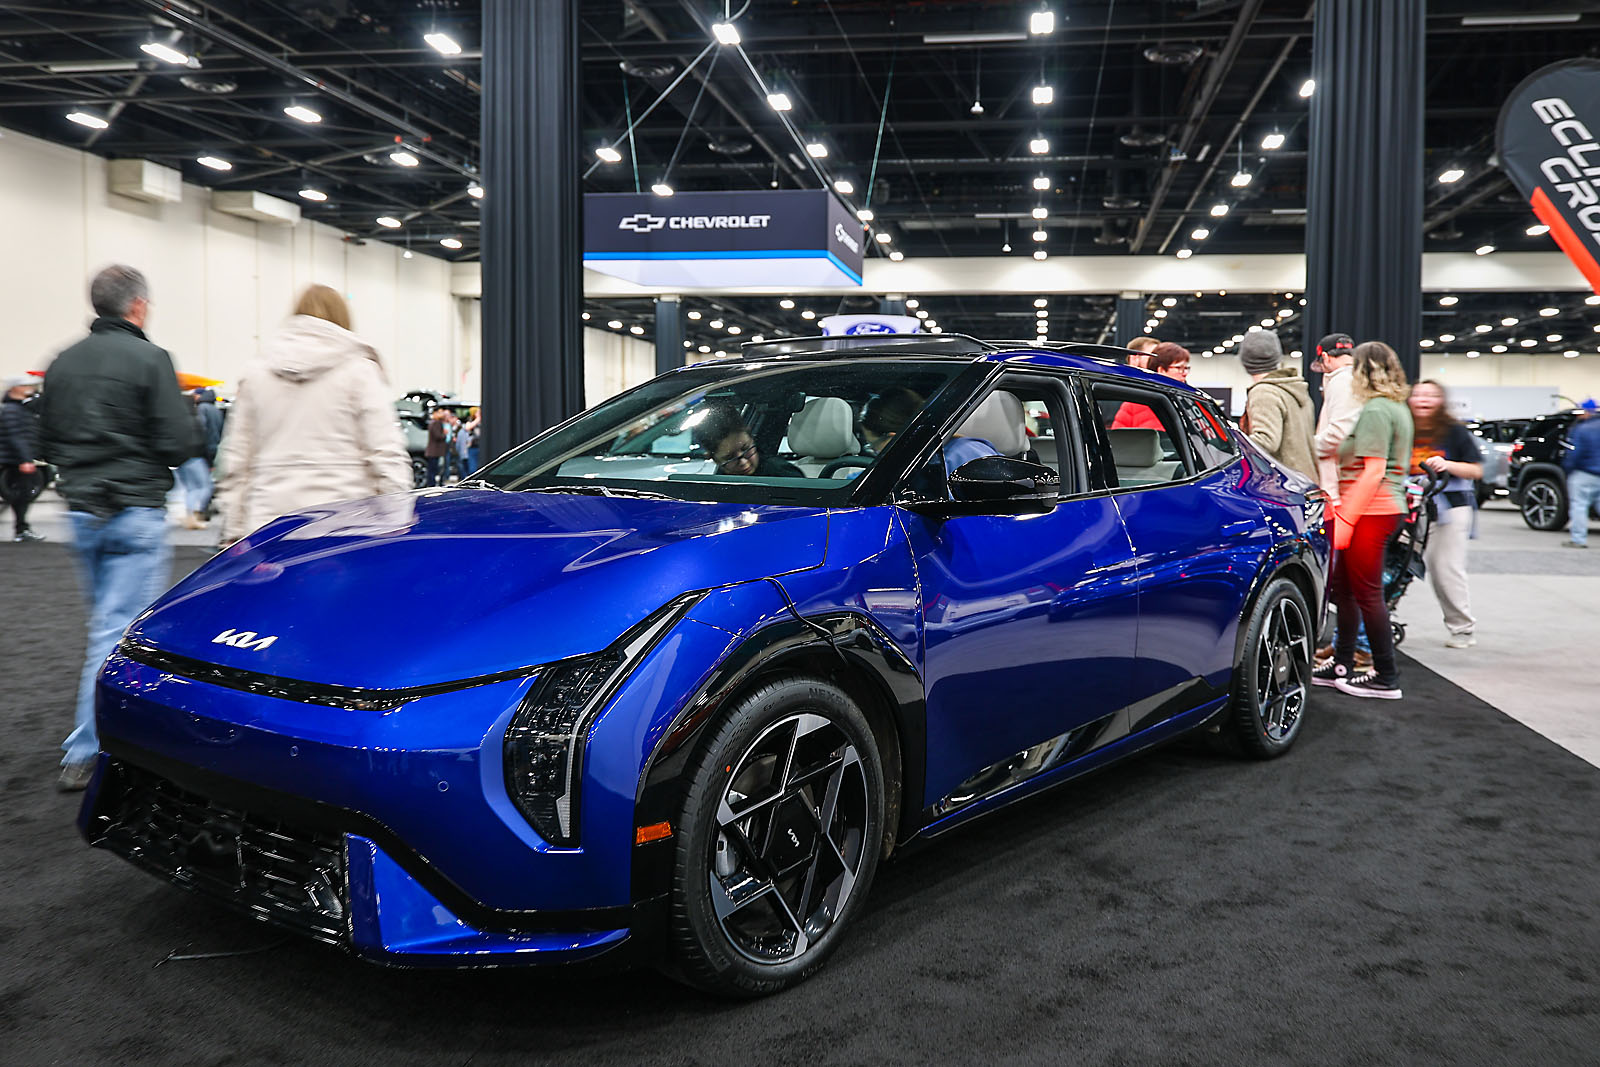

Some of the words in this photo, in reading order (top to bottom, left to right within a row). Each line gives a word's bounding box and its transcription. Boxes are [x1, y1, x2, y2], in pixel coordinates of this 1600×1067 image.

[1540, 156, 1600, 247] CRO
[669, 215, 771, 229] CHEVROLET
[211, 628, 279, 652] KIA
